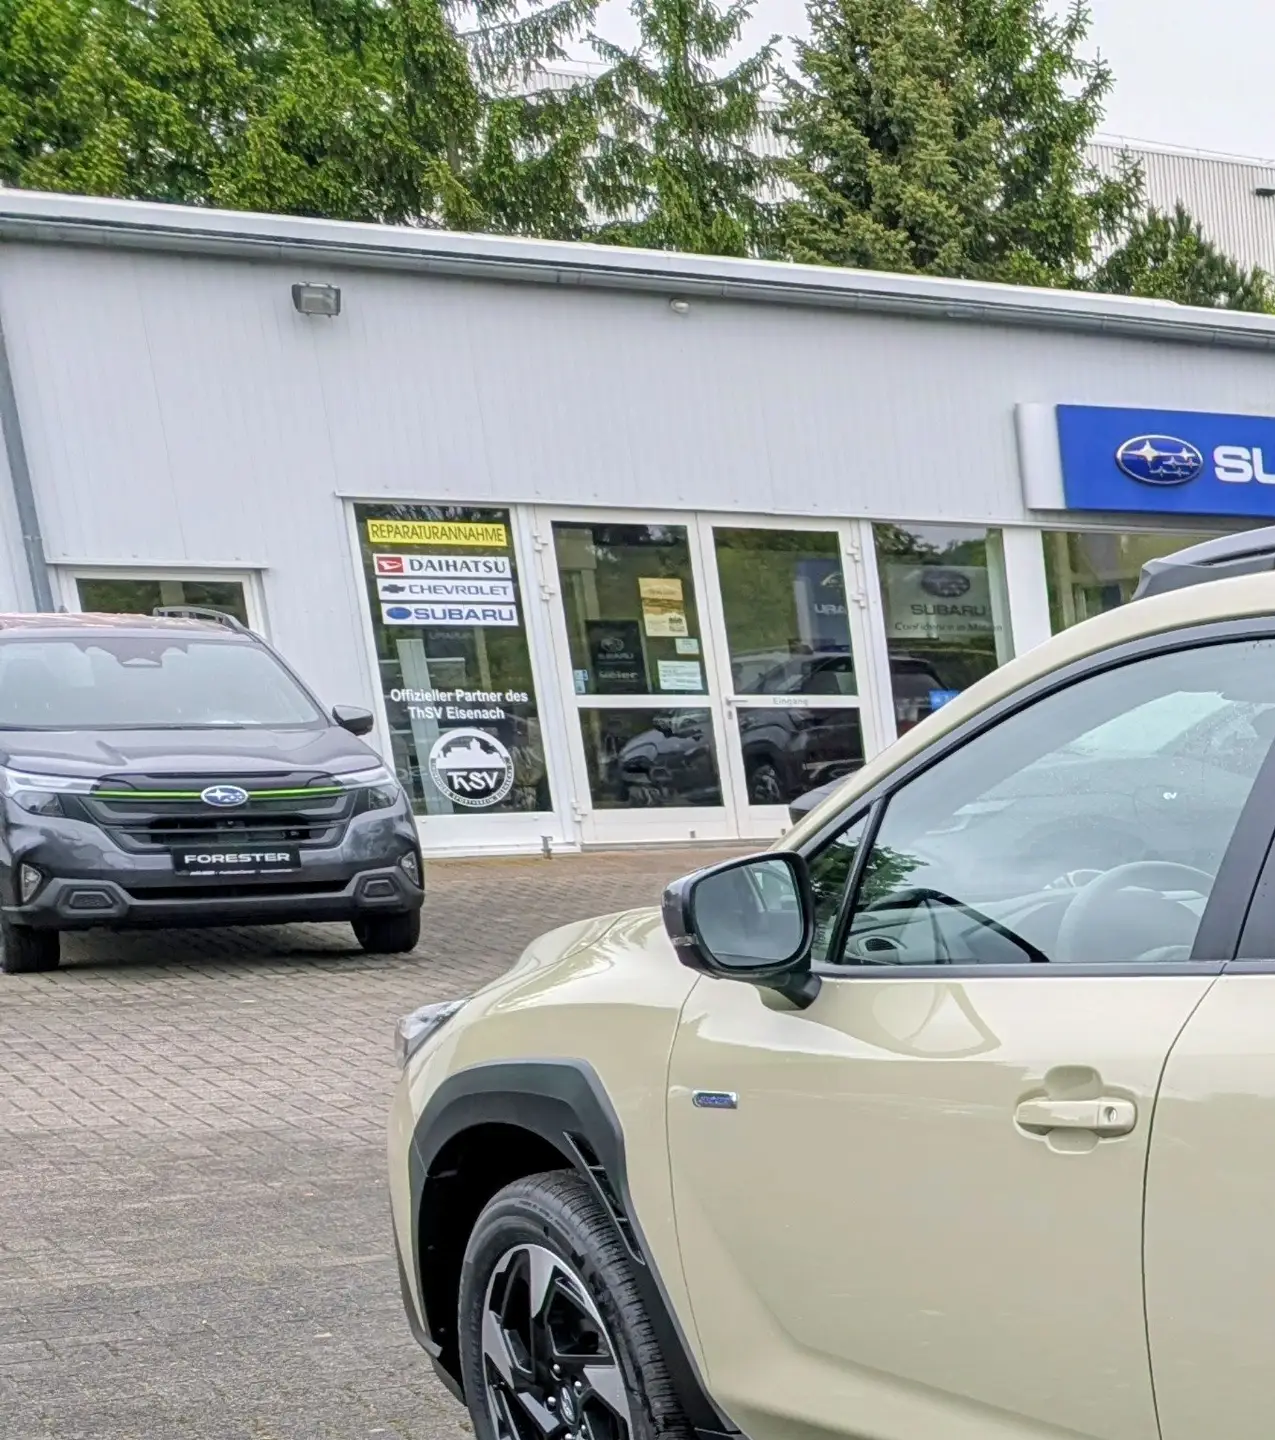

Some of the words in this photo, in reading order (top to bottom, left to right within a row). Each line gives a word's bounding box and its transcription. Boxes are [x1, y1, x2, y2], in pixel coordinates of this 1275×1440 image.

[370, 523, 505, 542] REPARATURANNAHME
[409, 558, 507, 574] DAIHATSU
[408, 583, 510, 596] CHEVROLET
[413, 607, 514, 621] SUBARU
[910, 603, 986, 616] SUBARU
[390, 688, 452, 702] Offizieller
[455, 688, 503, 702] Partner
[505, 688, 529, 702] des
[772, 696, 809, 707] Eingang
[407, 706, 443, 720] ThSV
[446, 706, 506, 720] Eisenach
[184, 852, 290, 864] FORESTER
